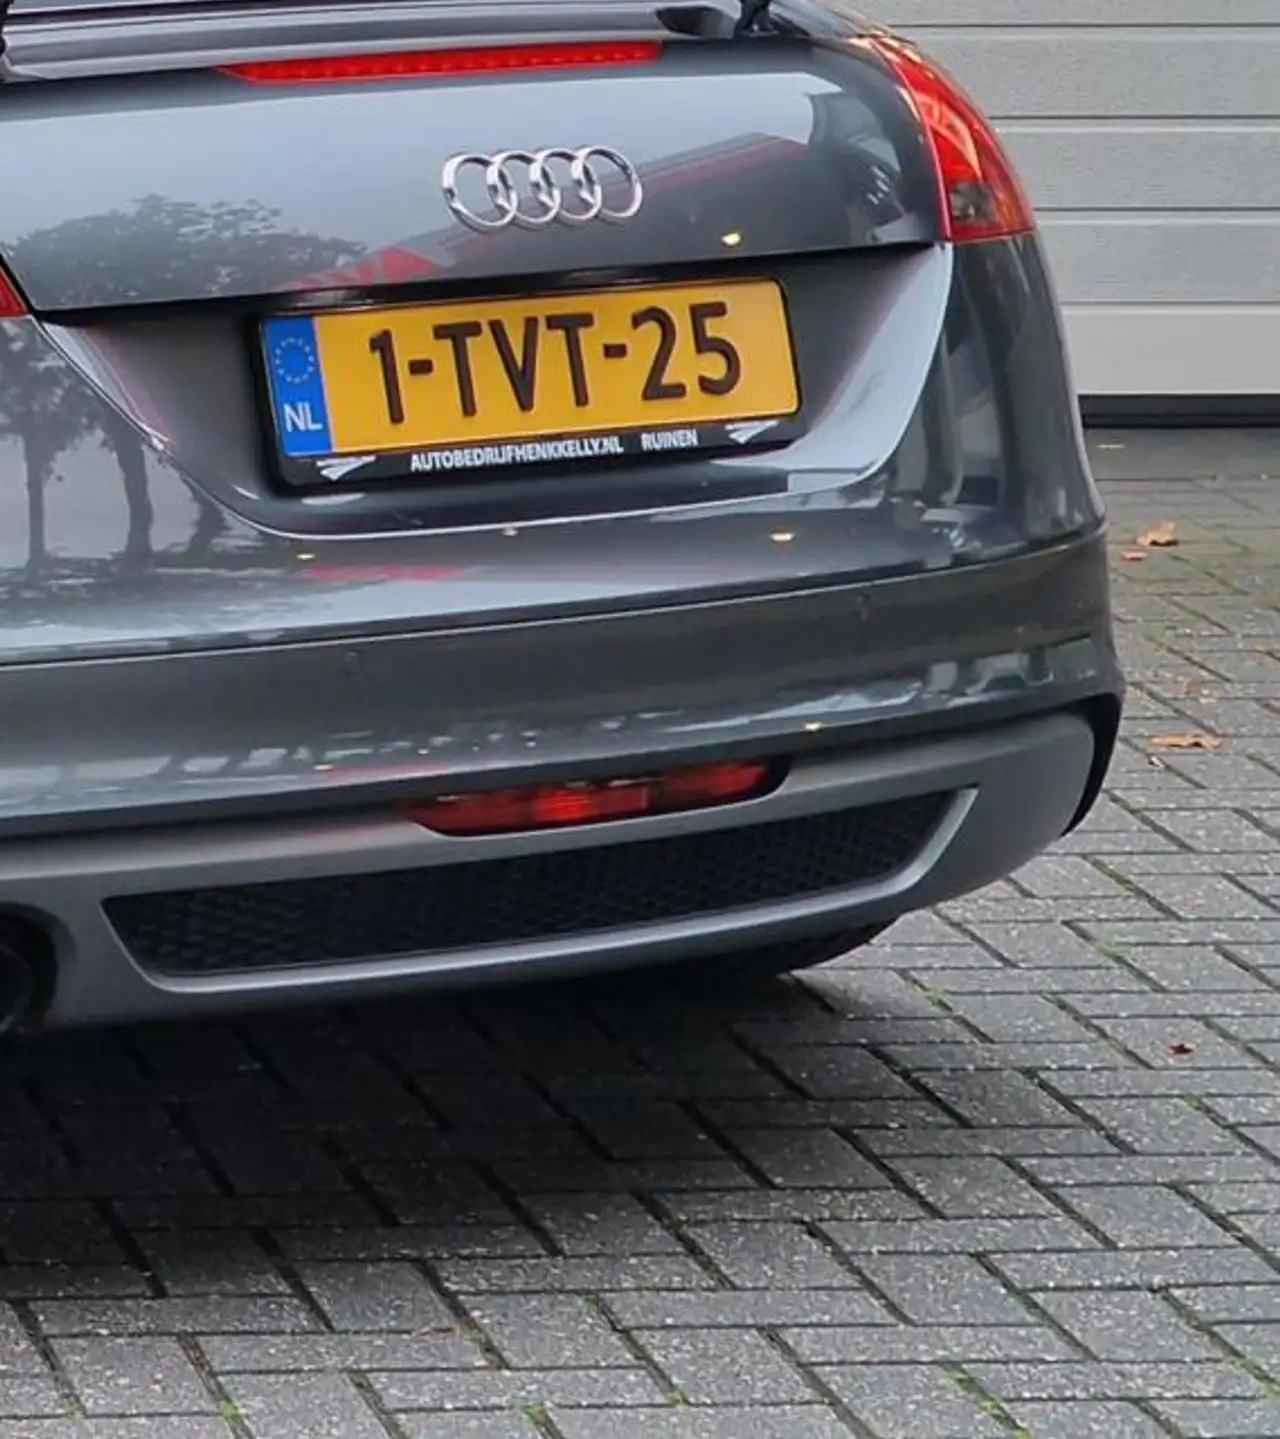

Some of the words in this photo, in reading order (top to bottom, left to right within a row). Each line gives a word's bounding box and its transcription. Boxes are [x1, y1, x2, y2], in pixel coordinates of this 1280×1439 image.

[369, 301, 741, 424] 1-TVT-25
[284, 402, 322, 432] NL
[410, 437, 624, 471] AUTOBEDRIJFHENKKELLY.NL
[640, 428, 699, 450] RUINEN
